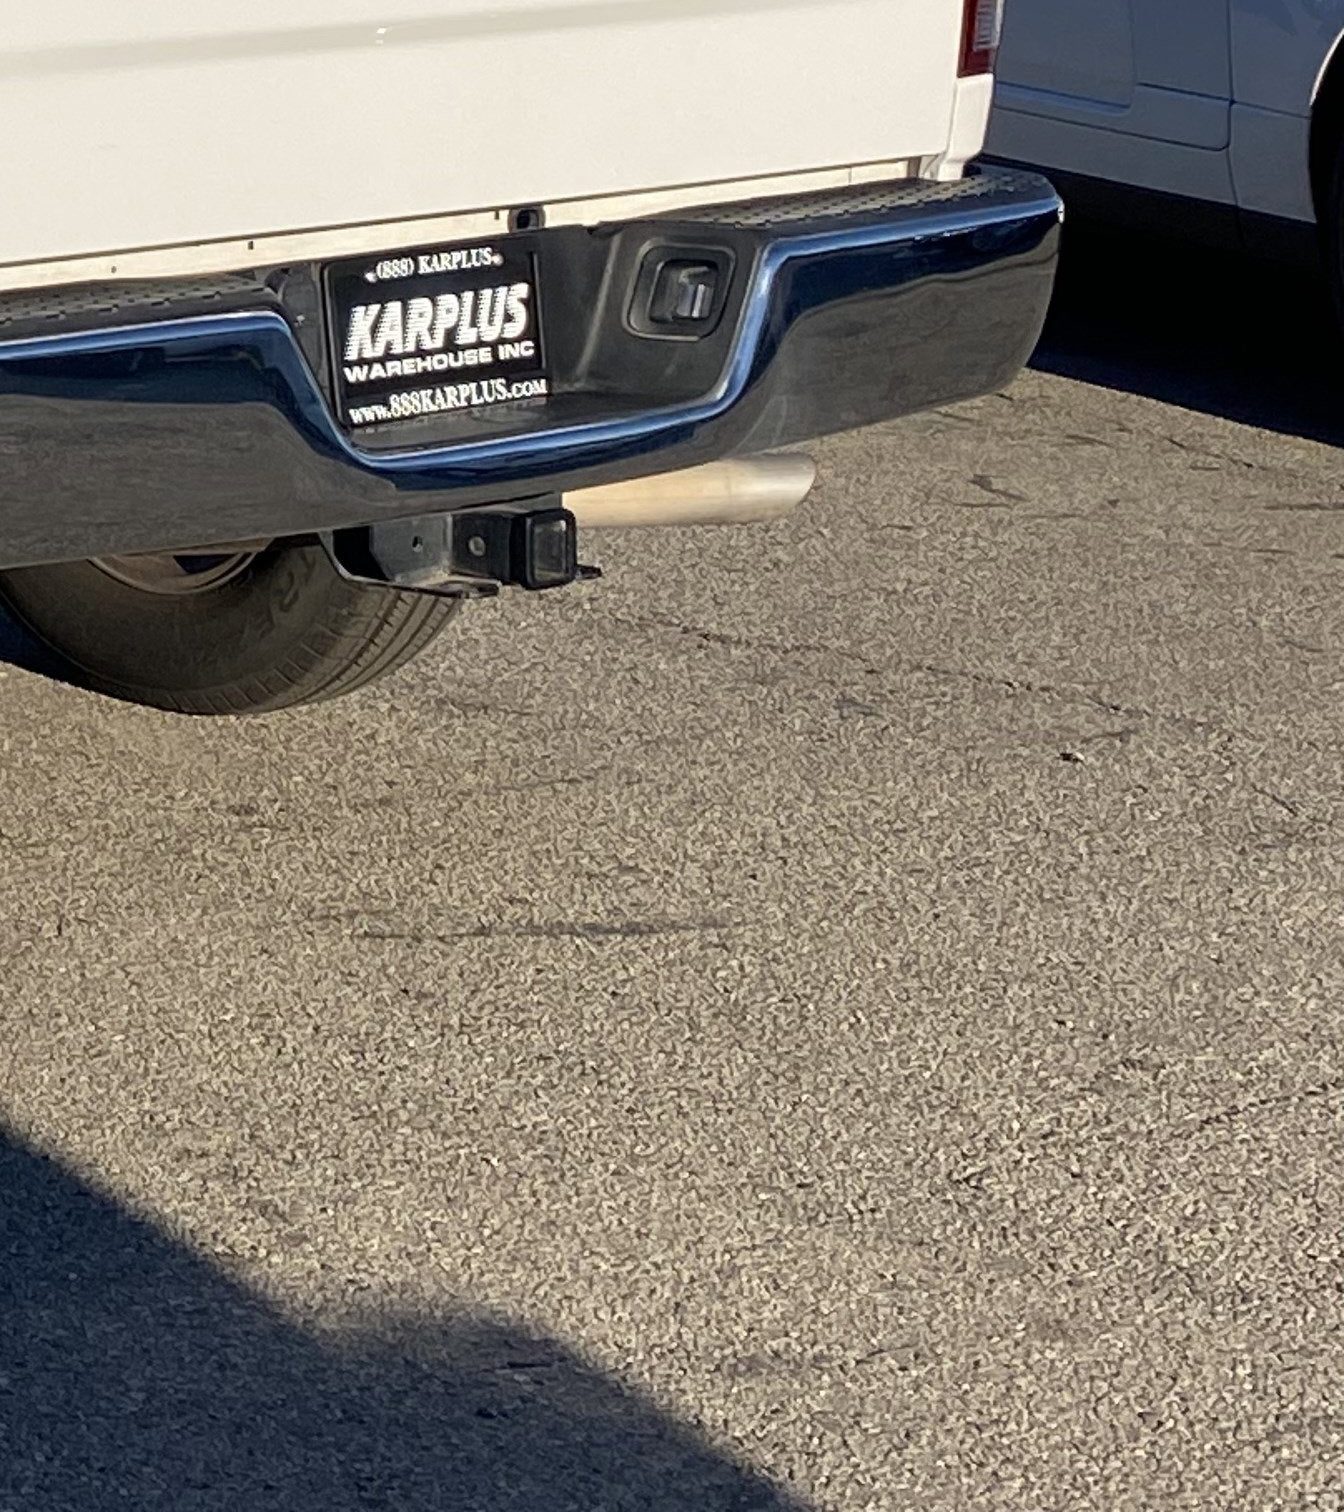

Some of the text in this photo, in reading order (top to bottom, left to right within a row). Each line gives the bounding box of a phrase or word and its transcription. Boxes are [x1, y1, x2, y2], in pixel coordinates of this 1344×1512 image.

[375, 246, 494, 280] (888) KARPLUS
[343, 282, 530, 362] KARPLUS
[342, 340, 536, 384] WAREHOUSE INC
